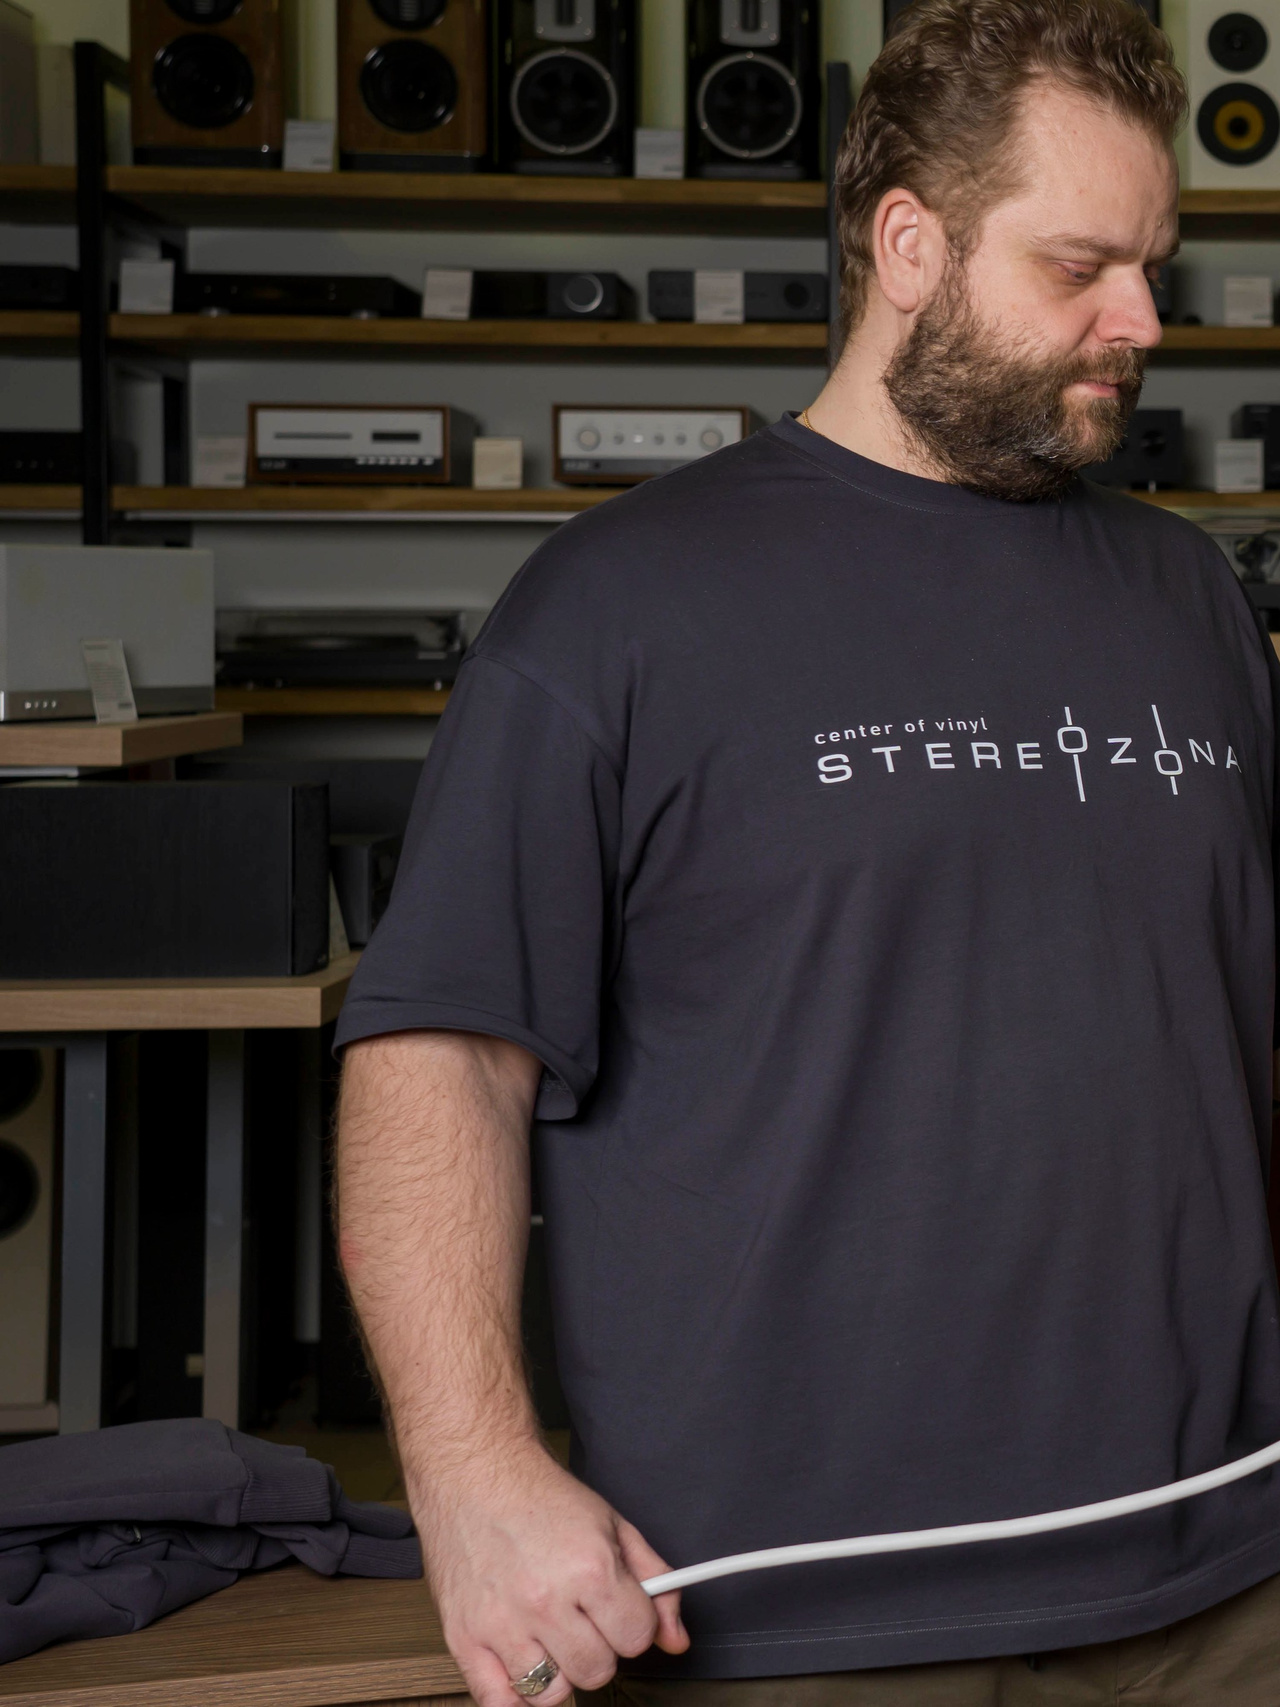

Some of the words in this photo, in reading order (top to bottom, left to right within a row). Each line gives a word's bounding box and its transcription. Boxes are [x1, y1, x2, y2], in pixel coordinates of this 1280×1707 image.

[814, 720, 893, 745] center
[904, 718, 926, 733] of
[935, 716, 989, 733] vinyl
[817, 704, 1243, 802] STEREOZONA
